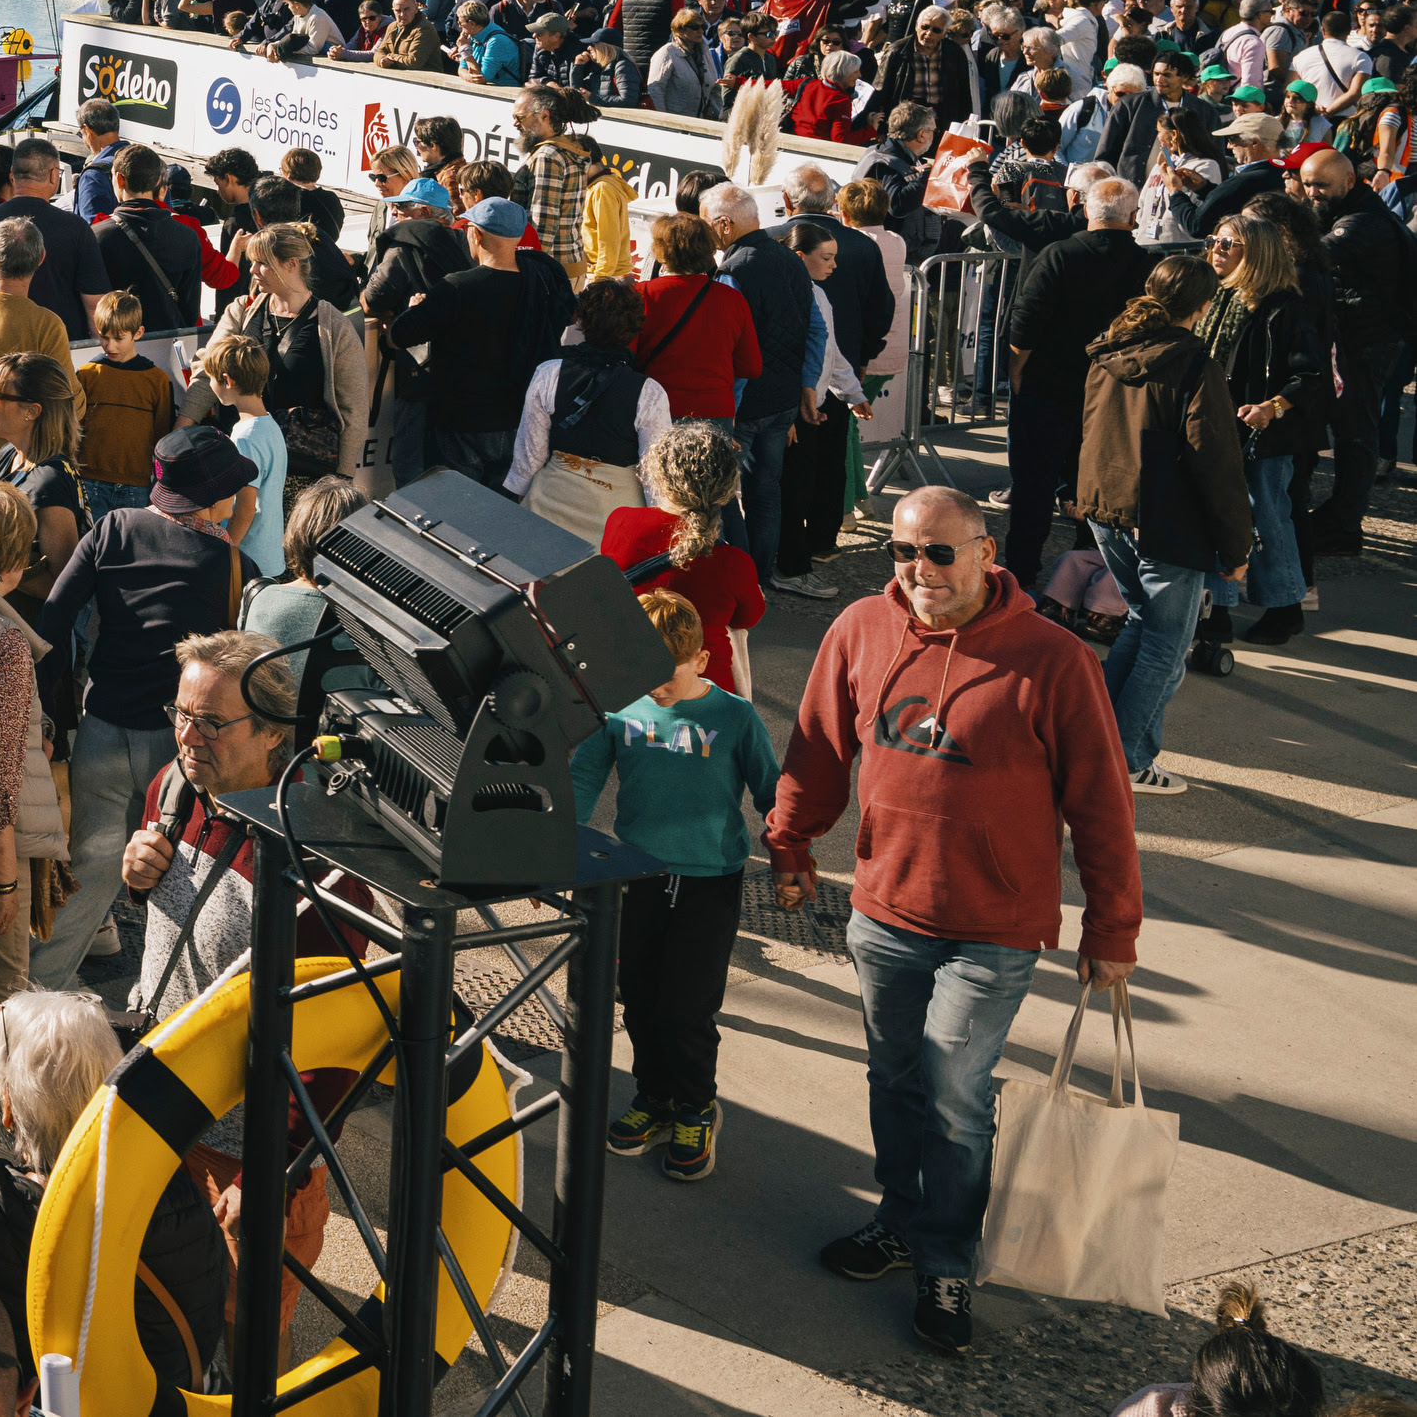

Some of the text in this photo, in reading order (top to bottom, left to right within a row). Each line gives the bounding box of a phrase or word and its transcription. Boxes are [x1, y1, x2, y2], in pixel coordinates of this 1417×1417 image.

[84, 52, 171, 105] Sodebo
[251, 87, 339, 131] les Sables
[623, 718, 719, 759] PLAY
